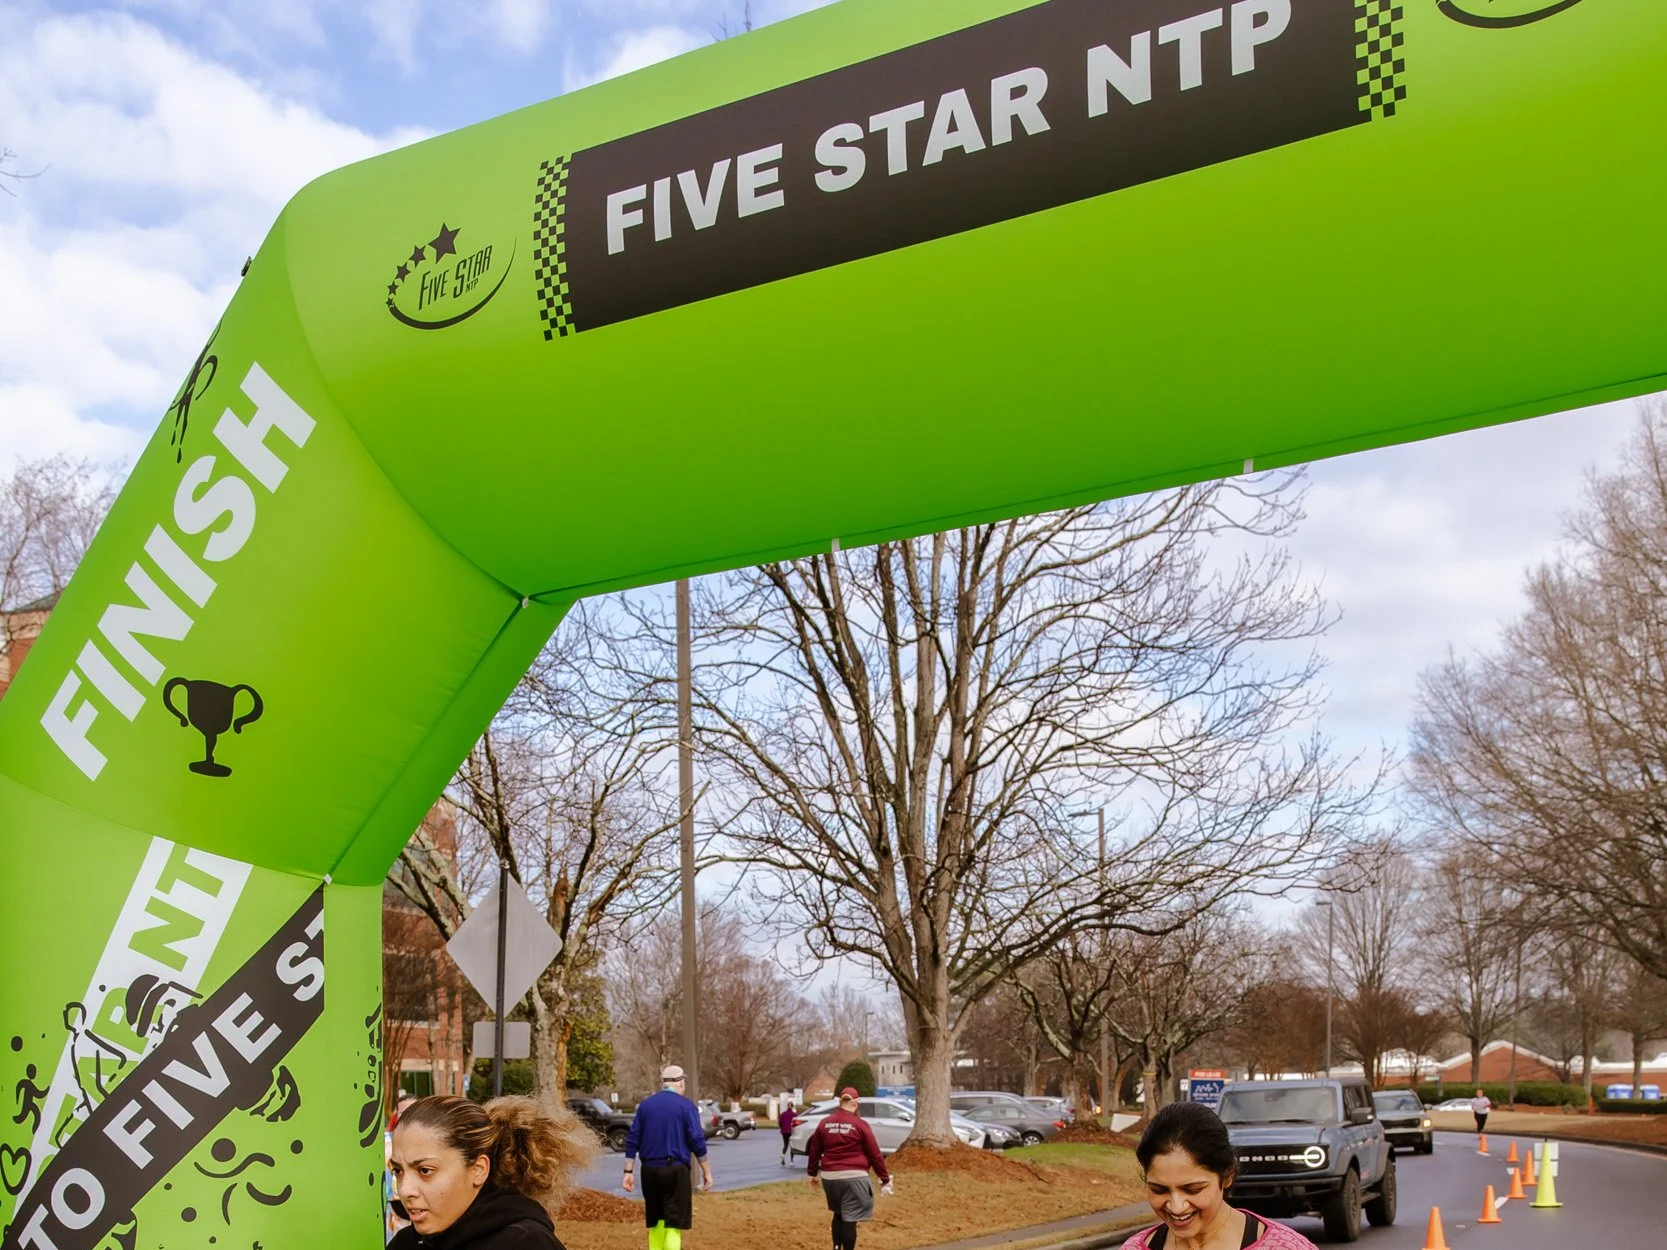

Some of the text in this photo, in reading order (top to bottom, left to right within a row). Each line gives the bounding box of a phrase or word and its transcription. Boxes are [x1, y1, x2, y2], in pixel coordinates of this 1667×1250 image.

[606, 0, 1293, 255] FIVE STAR NTP
[40, 361, 317, 782] FINISH
[102, 991, 282, 1170] FIVE
